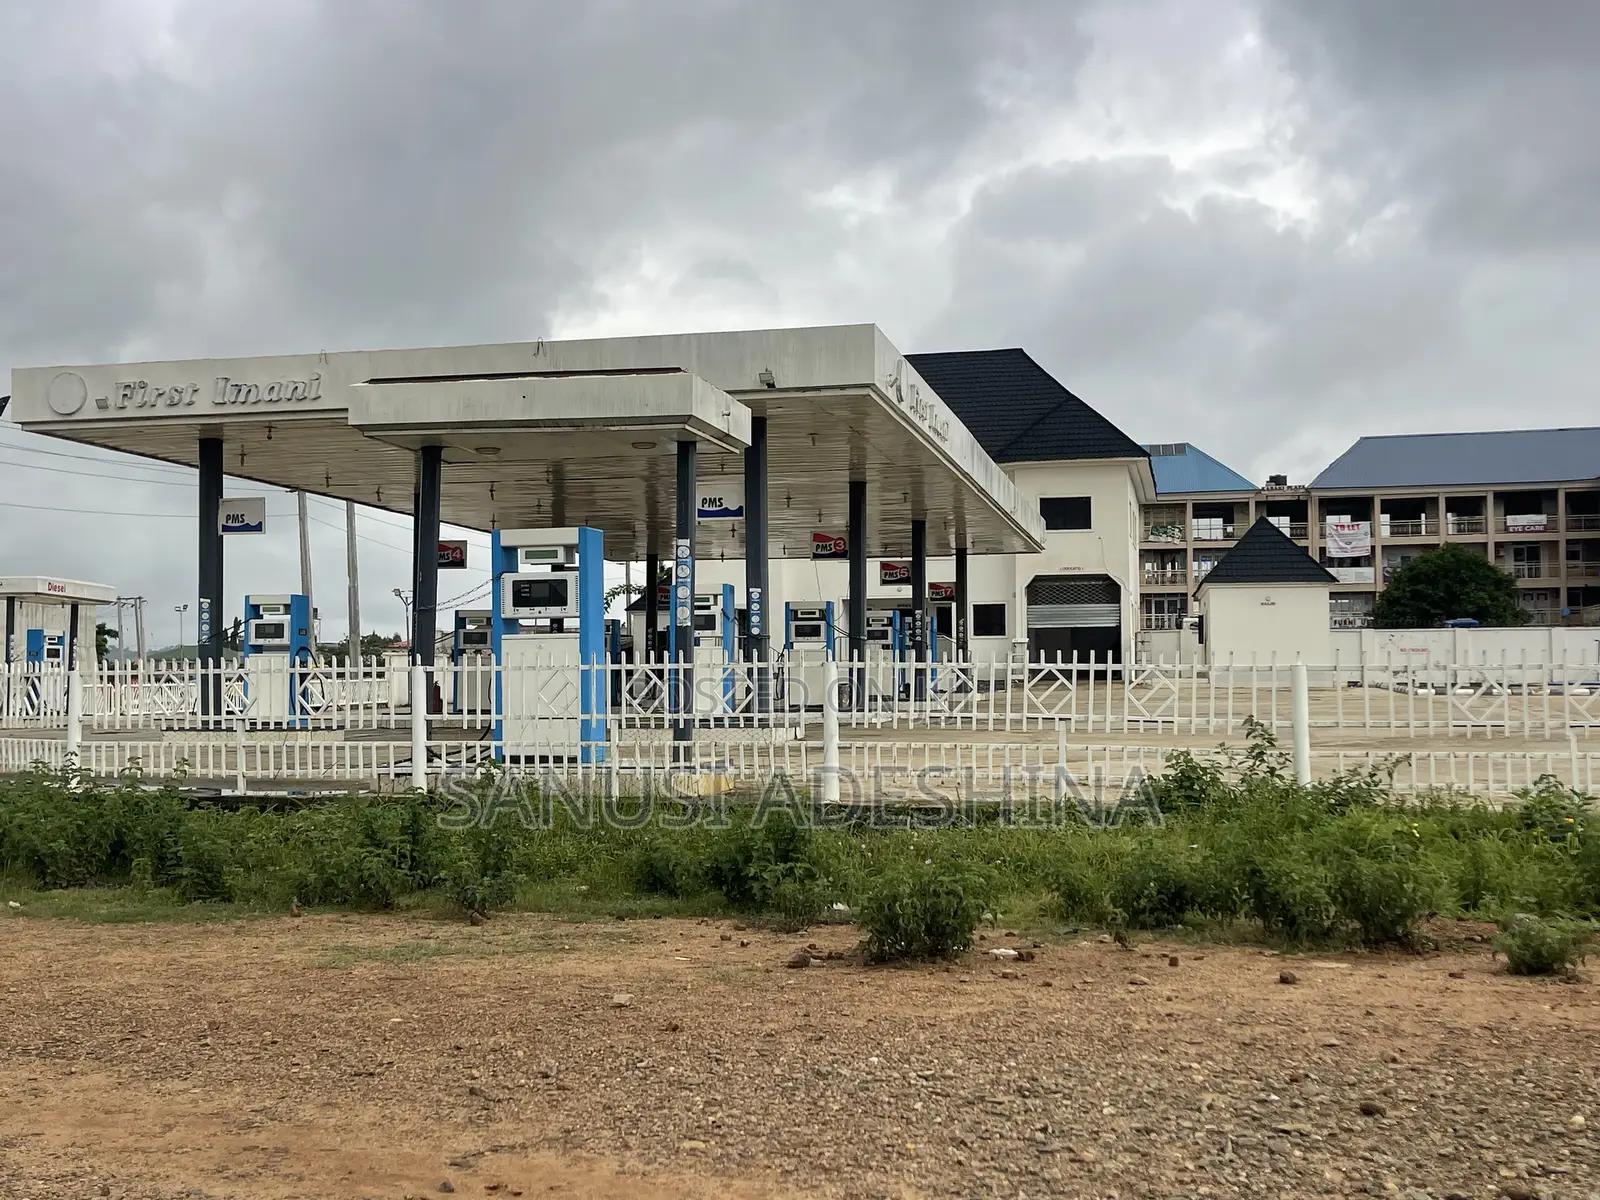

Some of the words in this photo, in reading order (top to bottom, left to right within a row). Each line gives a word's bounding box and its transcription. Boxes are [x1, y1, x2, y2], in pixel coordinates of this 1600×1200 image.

[113, 380, 200, 409] First
[211, 372, 323, 406] Imani
[702, 496, 724, 508] PMS
[225, 513, 246, 525] PMS
[815, 542, 833, 552] PMS
[835, 540, 845, 550] 3
[438, 552, 450, 561] MS
[451, 549, 462, 559] 4
[900, 568, 908, 578] 5
[47, 582, 66, 593] Diesel
[945, 588, 952, 596] 7
